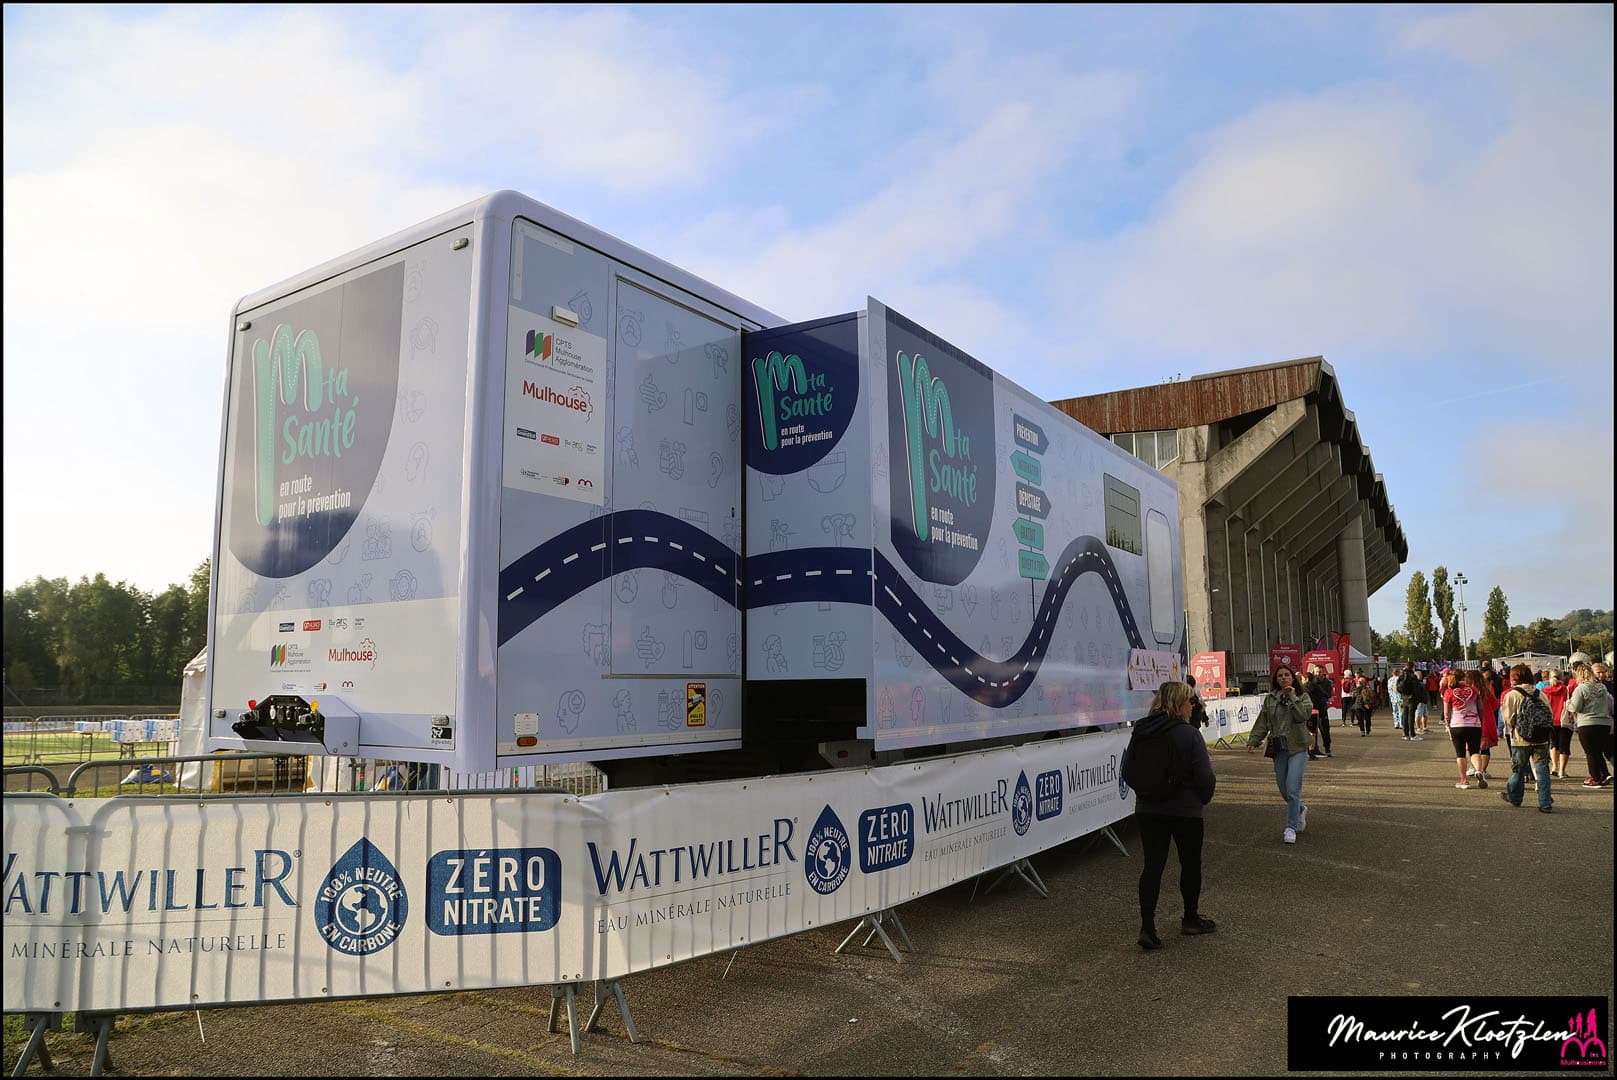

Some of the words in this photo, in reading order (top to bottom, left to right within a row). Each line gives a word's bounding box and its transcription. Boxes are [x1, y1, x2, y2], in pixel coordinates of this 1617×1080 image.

[522, 380, 587, 412] Mulhouse
[781, 386, 834, 421] Santé
[282, 394, 360, 465] Santé
[781, 427, 789, 436] en
[789, 423, 805, 435] route
[781, 436, 794, 448] pour
[795, 434, 801, 444] la
[802, 430, 833, 446] prévention
[1016, 423, 1039, 447] PRÉVENTION
[280, 480, 290, 497] en
[291, 474, 312, 495] route
[929, 448, 977, 508] Santé
[278, 501, 297, 524] pour
[298, 495, 306, 516] la
[307, 488, 351, 519] prévention
[1018, 487, 1041, 512] DÉPISTAGE
[930, 506, 939, 521] en
[939, 508, 954, 526] route
[931, 525, 944, 544] pour
[945, 525, 951, 544] la
[951, 529, 979, 552] prévention
[328, 648, 373, 662] Mulhouse
[1039, 773, 1060, 798] ZÉRO
[1039, 796, 1060, 816] NITRATE
[867, 808, 910, 843] ZÉRO
[808, 831, 823, 857] 100%
[823, 826, 849, 851] NEUTRE
[867, 838, 908, 867] NITRATE
[924, 849, 938, 862] EAU
[320, 871, 353, 902] 100%
[355, 867, 404, 901] NEUTRE
[445, 850, 545, 894] ZÉRO
[808, 871, 819, 887] EN
[817, 864, 849, 893] CARBONE
[443, 896, 542, 926] NITRATE
[597, 915, 628, 934] EAU
[635, 898, 711, 927] MINÉRALE
[717, 882, 792, 911] NATURELLE
[11, 938, 134, 959] MINÉRALE
[148, 933, 286, 955] NATURELLE
[321, 922, 341, 942] EN
[339, 919, 401, 952] CARBONE
